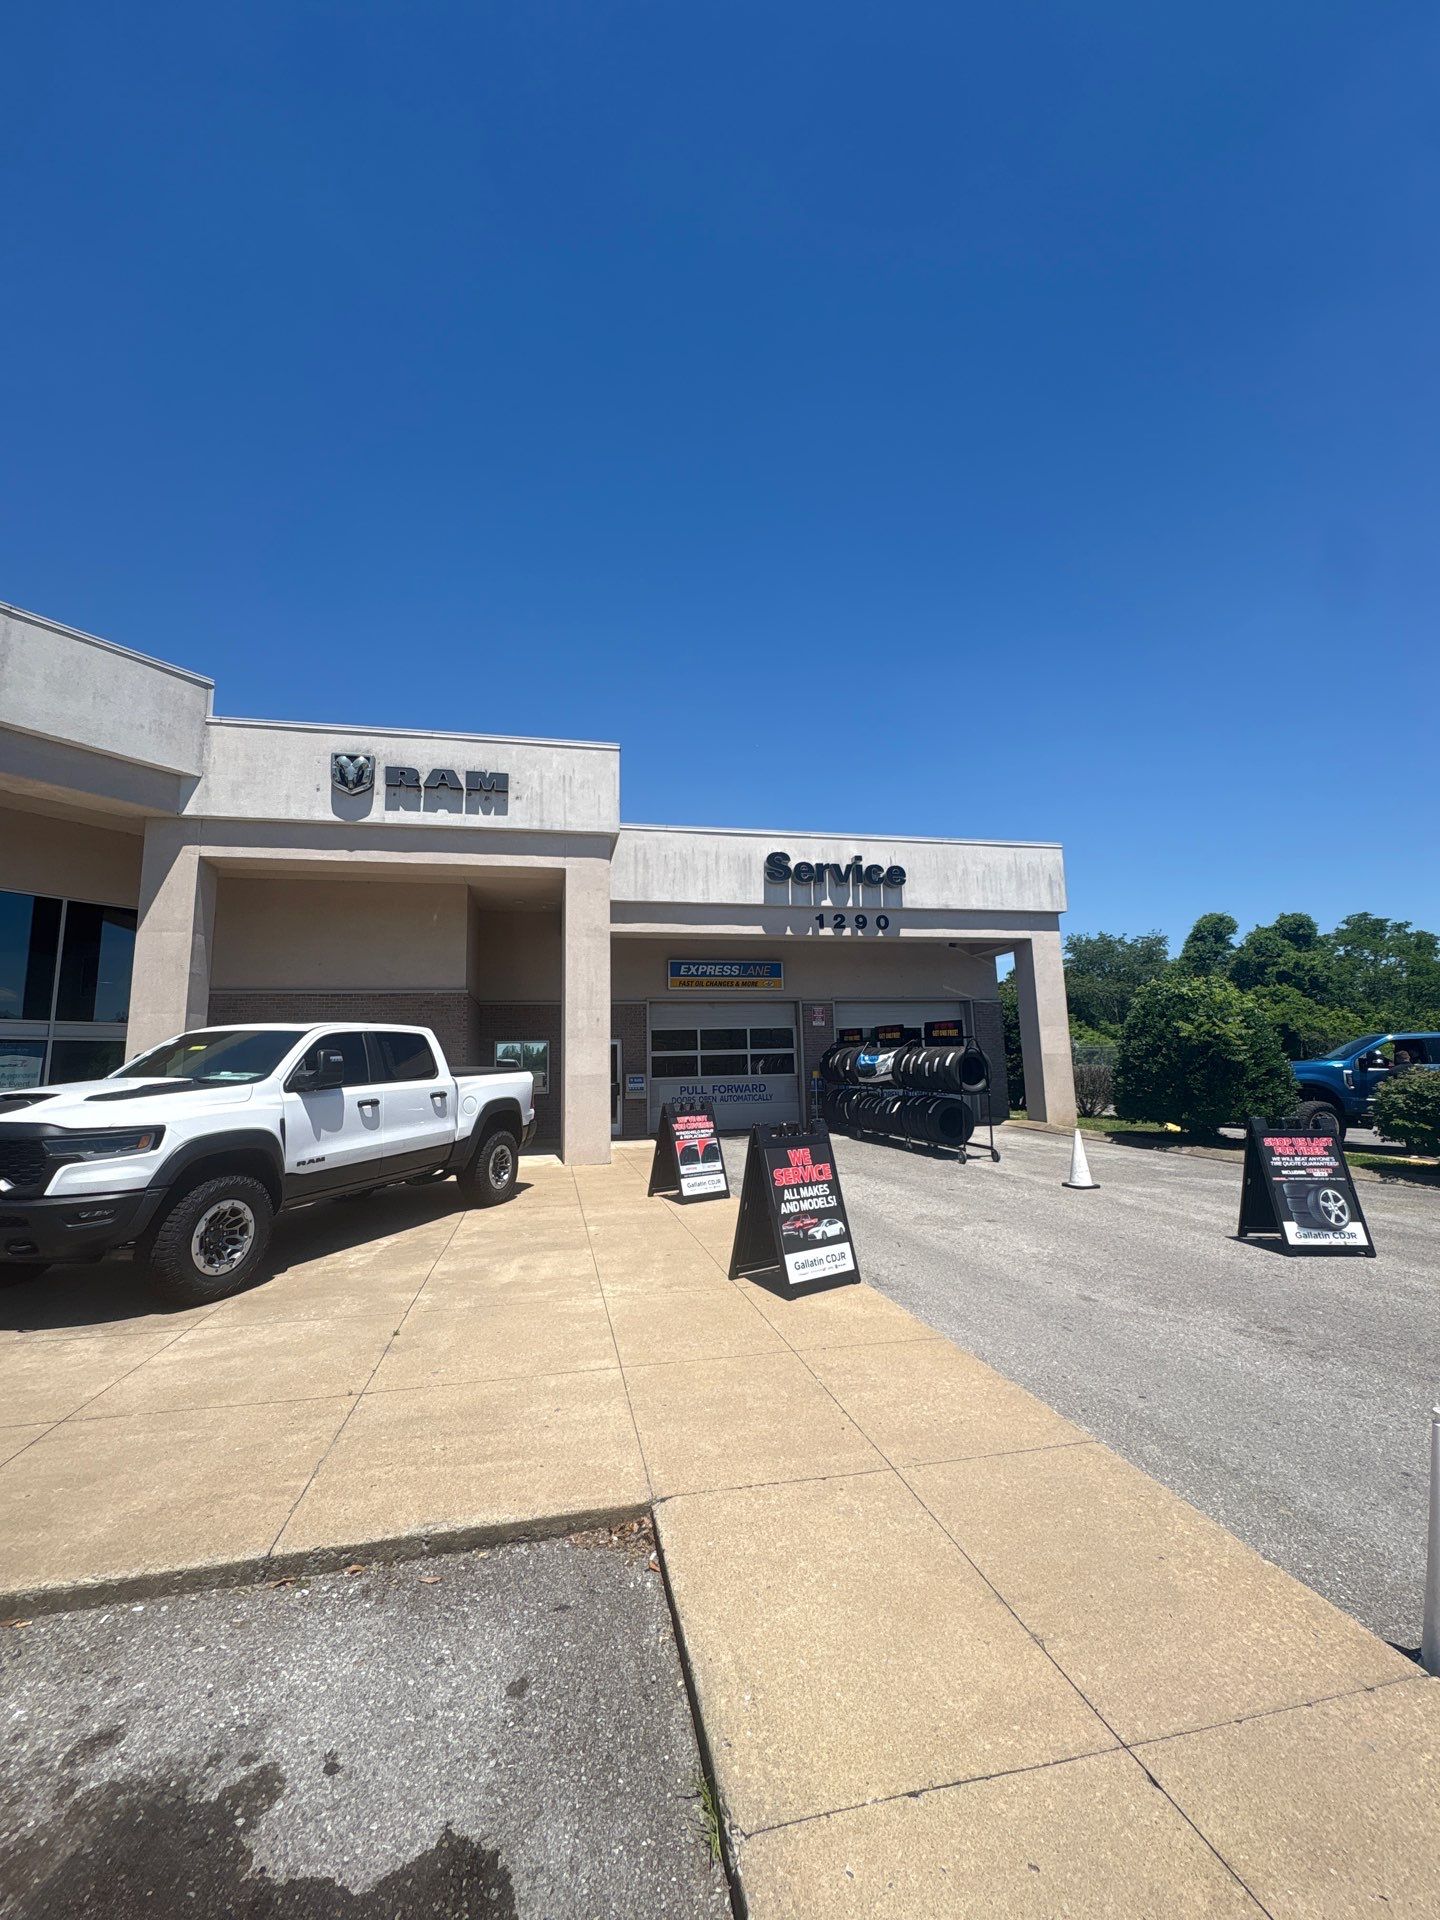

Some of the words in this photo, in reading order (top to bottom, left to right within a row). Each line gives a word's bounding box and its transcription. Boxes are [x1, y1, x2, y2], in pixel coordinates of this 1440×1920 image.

[385, 766, 509, 792] RAM
[765, 851, 907, 889] Service
[815, 913, 890, 931] 1290
[680, 964, 771, 976] EXPRESSLANE
[678, 980, 694, 988] FAST
[695, 980, 705, 988] OIL
[705, 980, 733, 988] CHANGES
[680, 1086, 707, 1095] PULL
[712, 1084, 767, 1094] FORWARD
[699, 1095, 717, 1103] OPEN
[720, 1094, 773, 1103] AUTOMATICALLY
[1263, 1137, 1291, 1147] SHOP
[1292, 1137, 1308, 1147] US
[1308, 1137, 1333, 1147] LAST
[787, 1147, 812, 1167] WE
[1274, 1147, 1295, 1156] FOR
[1296, 1147, 1329, 1156] TIRES.
[297, 1156, 325, 1167] RAM
[773, 1163, 832, 1187] SERVICE
[687, 1180, 707, 1188] Gallatin
[783, 1188, 800, 1201] ALL
[799, 1184, 830, 1199] MAKES
[780, 1201, 800, 1215] AND
[799, 1195, 837, 1213] MODELS!
[1295, 1231, 1330, 1240] Gallatin
[1331, 1231, 1358, 1240] CDJR
[794, 1256, 825, 1271] Gallatin
[825, 1251, 846, 1264] CDJR
